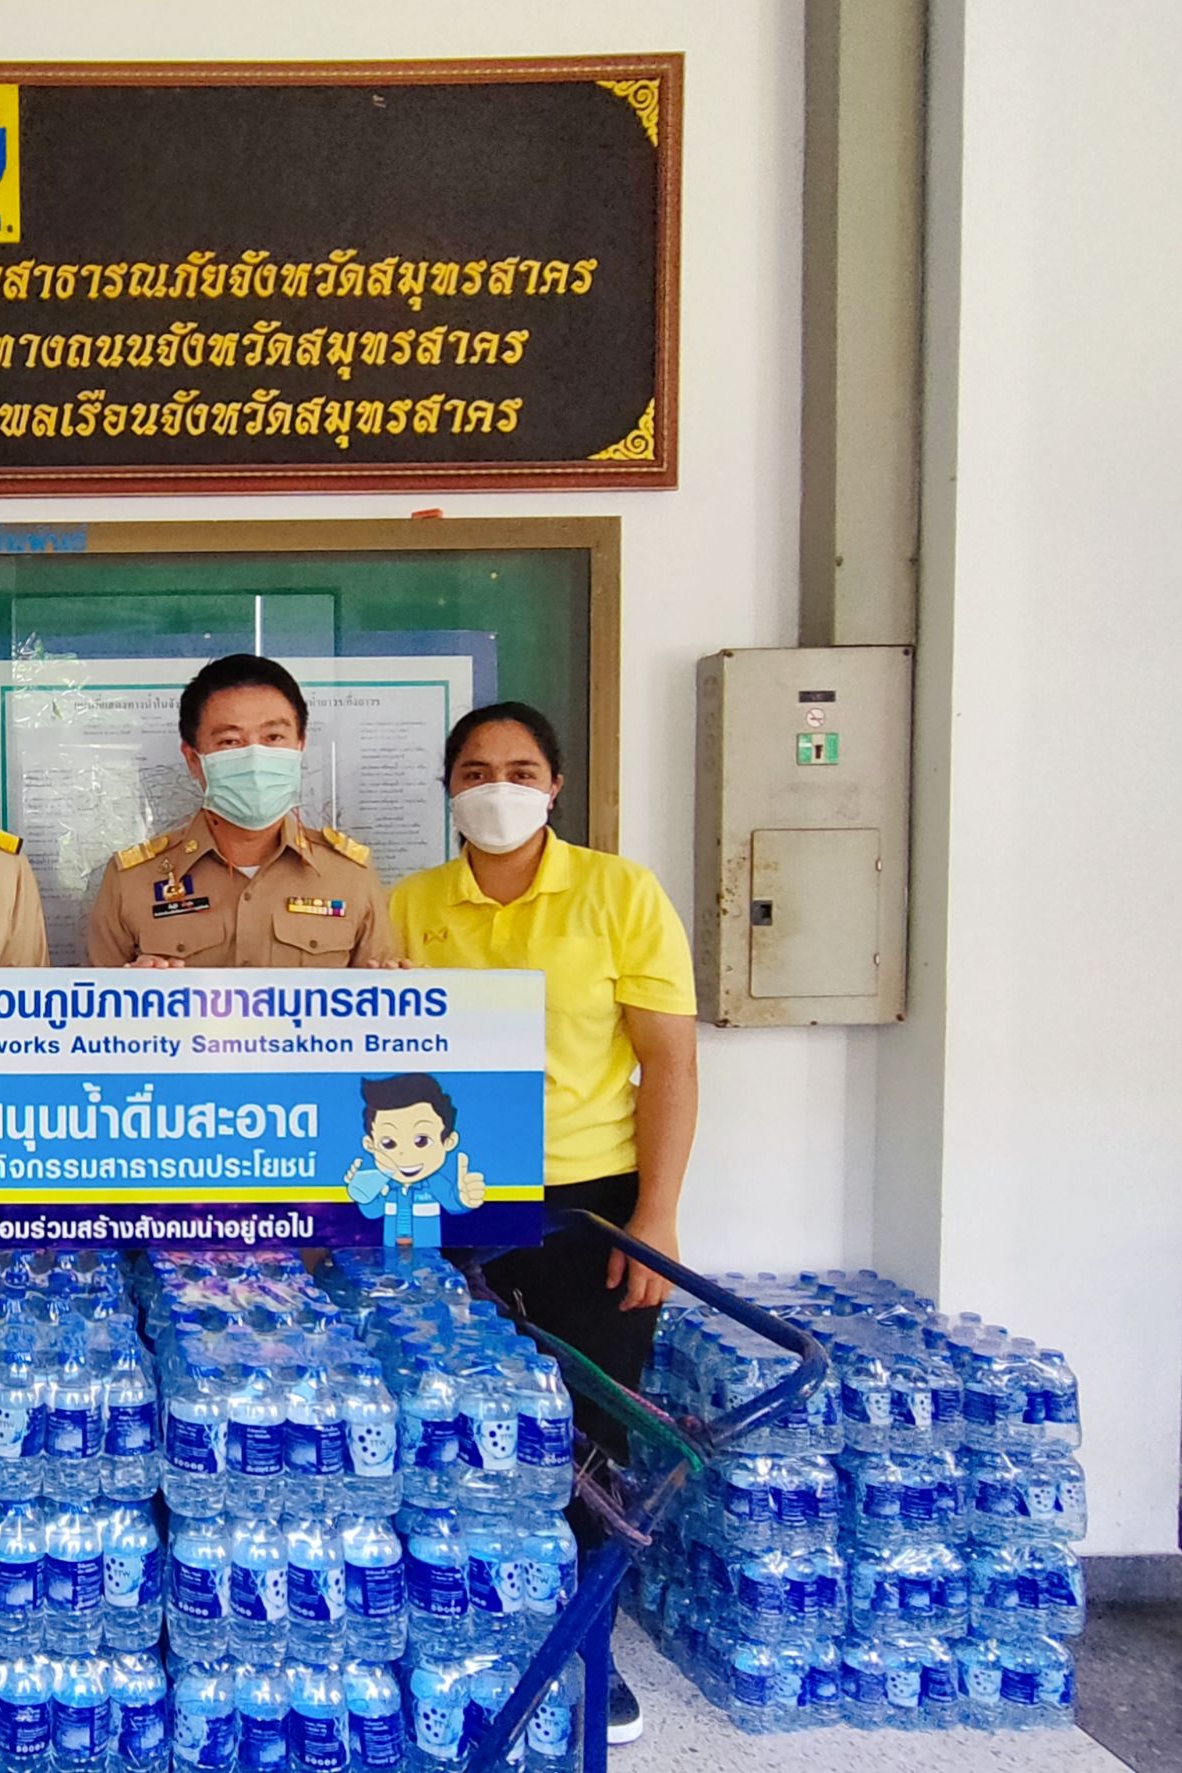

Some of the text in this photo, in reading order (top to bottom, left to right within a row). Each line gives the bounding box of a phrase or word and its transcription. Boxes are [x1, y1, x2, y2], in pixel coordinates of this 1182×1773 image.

[71, 1036, 181, 1057] Authority
[191, 1035, 354, 1055] Samutsakhon
[365, 1034, 449, 1053] Branch
